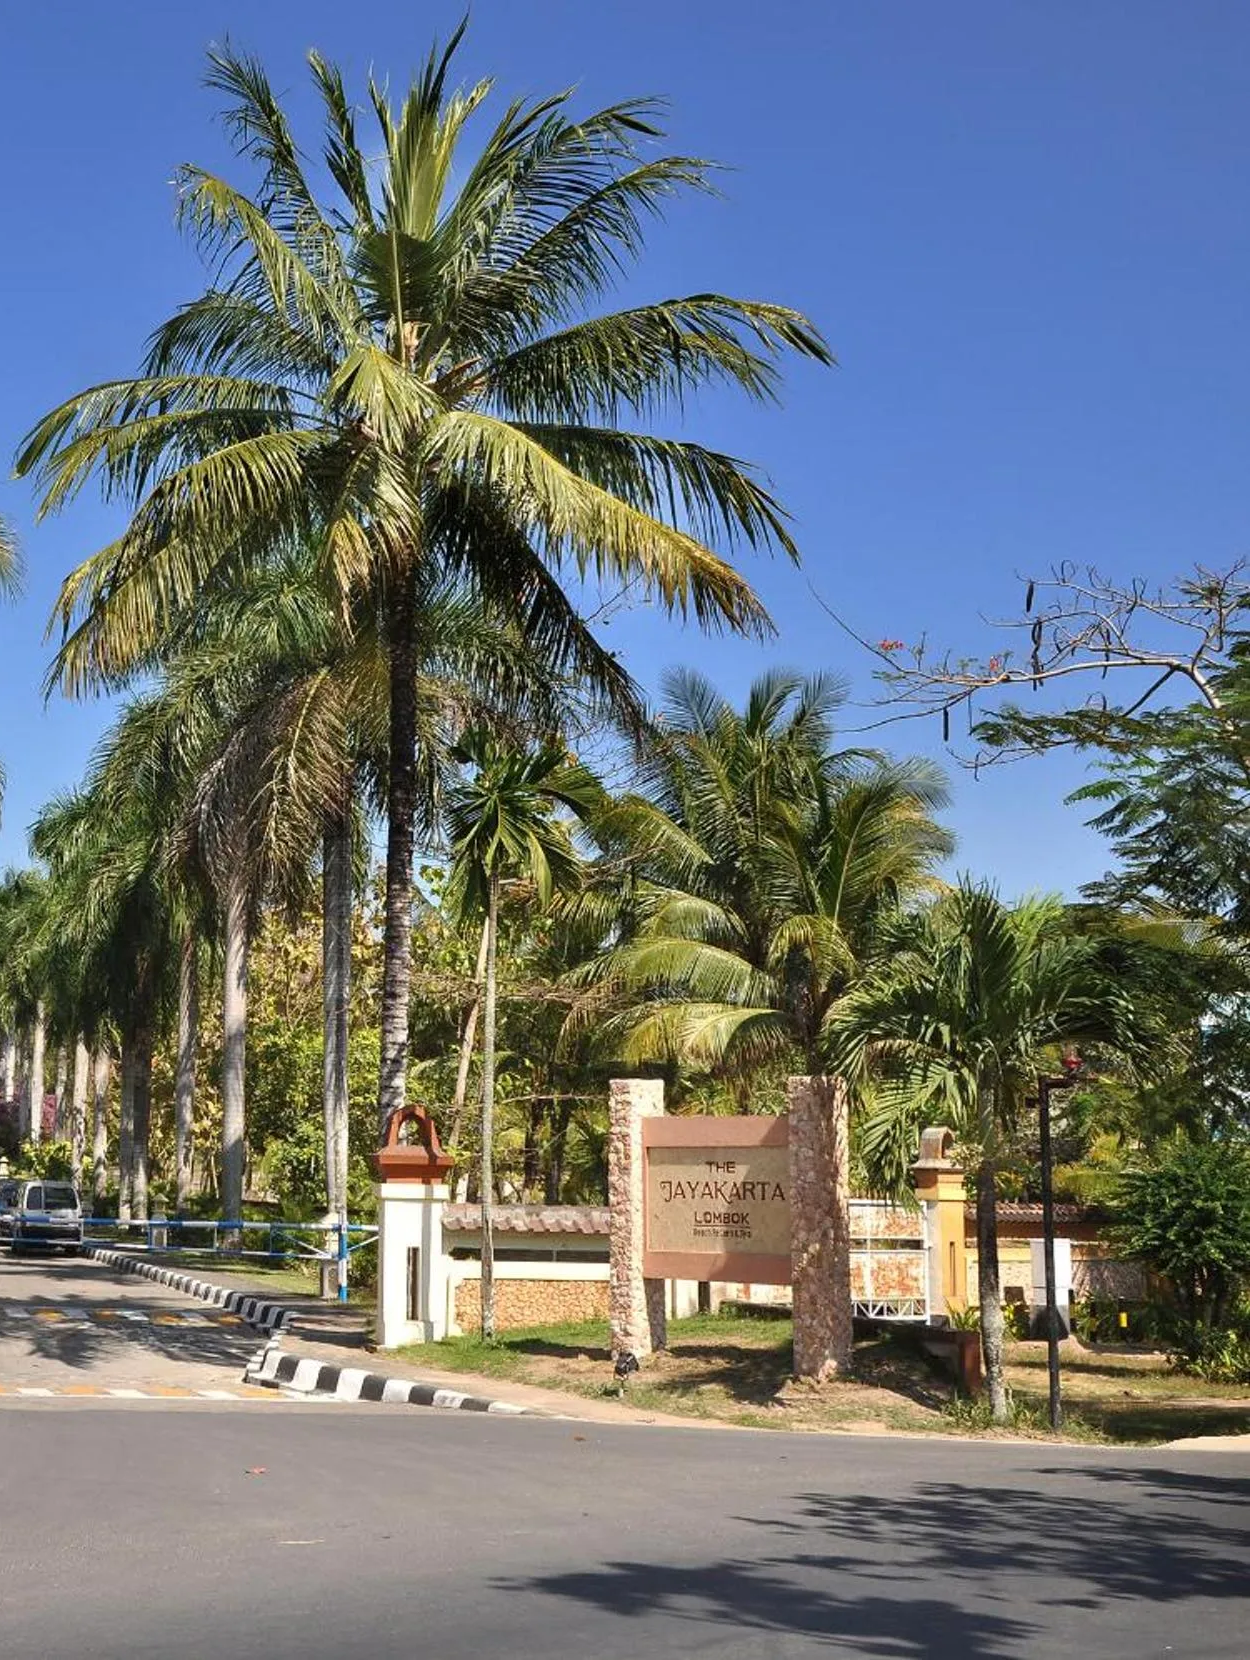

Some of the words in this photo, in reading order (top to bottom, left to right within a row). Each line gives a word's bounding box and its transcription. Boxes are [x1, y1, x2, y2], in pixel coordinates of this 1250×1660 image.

[705, 1161, 736, 1173] THE
[660, 1181, 786, 1204] JAYAKARTA
[693, 1211, 750, 1224] LOMBOK
